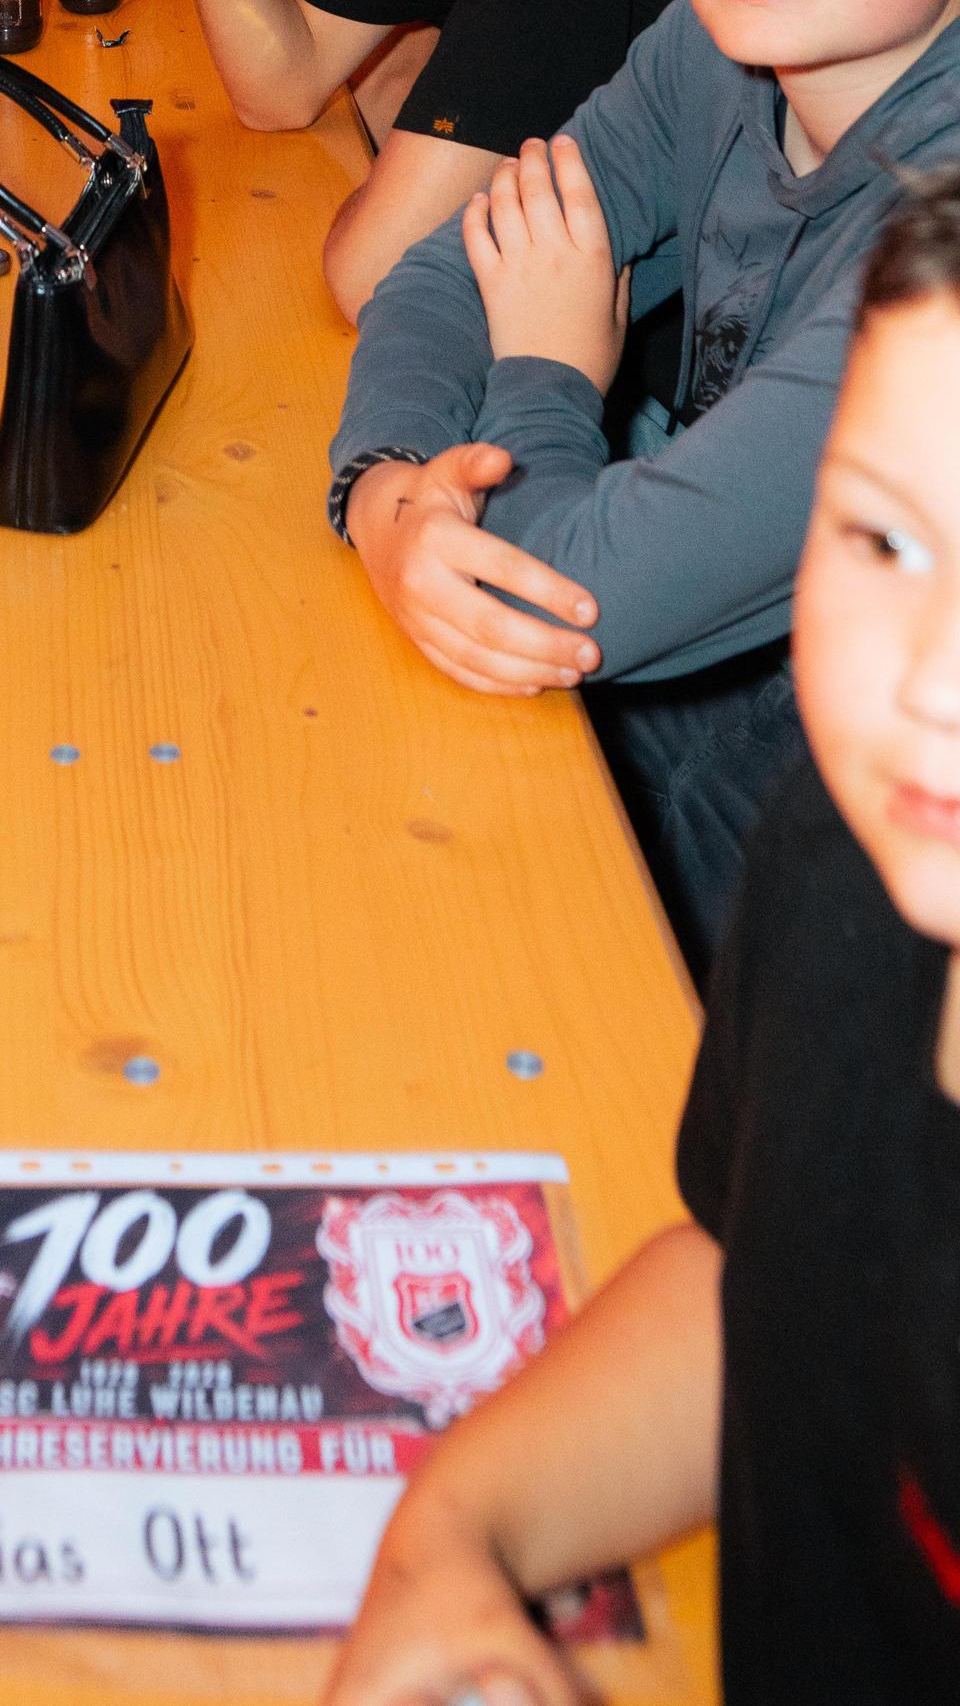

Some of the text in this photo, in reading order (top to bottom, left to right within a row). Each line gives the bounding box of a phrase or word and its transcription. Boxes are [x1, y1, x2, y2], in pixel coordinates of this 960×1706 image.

[4, 1190, 272, 1346] 100
[31, 1269, 305, 1360] JAHRE
[51, 1380, 139, 1420] LUHE
[149, 1382, 325, 1422] WILDENAU
[321, 1425, 396, 1475] FÜR
[143, 1506, 256, 1585] Ott
